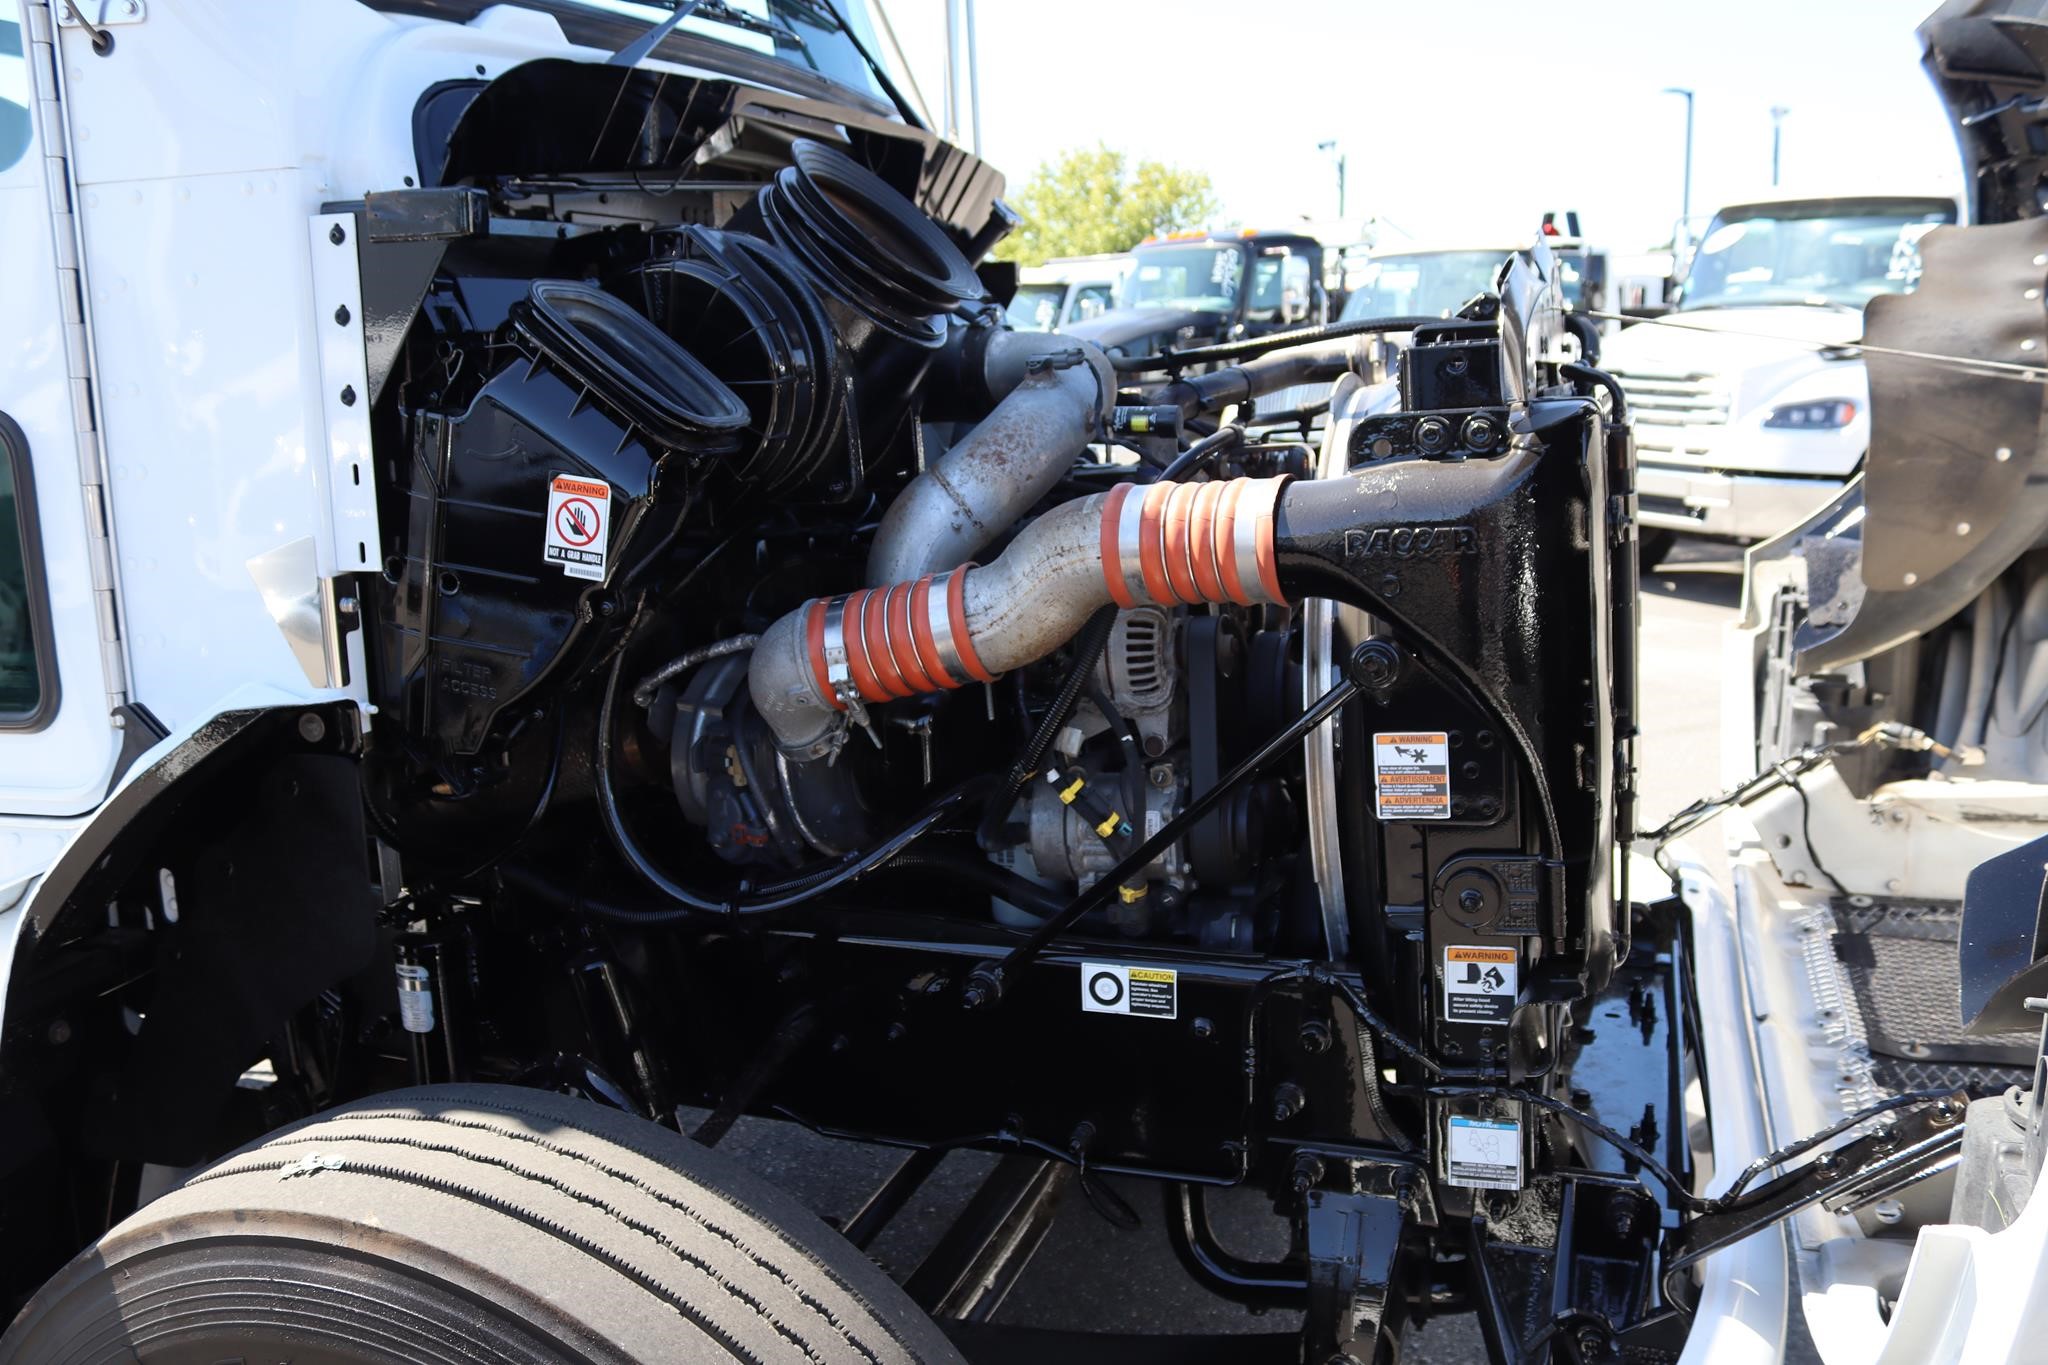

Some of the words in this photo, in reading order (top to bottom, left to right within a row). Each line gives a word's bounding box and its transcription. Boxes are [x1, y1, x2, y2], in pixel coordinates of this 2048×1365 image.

[562, 482, 605, 497] WARNING
[1344, 526, 1477, 557] PACCAR
[548, 547, 559, 557] NOT
[567, 550, 580, 560] GRAB
[581, 552, 602, 564] HANDLE
[442, 659, 491, 679] FILTER
[441, 677, 496, 699] ACCESS
[1400, 735, 1433, 743] WARNING
[1390, 775, 1445, 783] AVERTISSEMENT
[1462, 952, 1509, 961] WARNING
[1136, 971, 1174, 981] CAUTION
